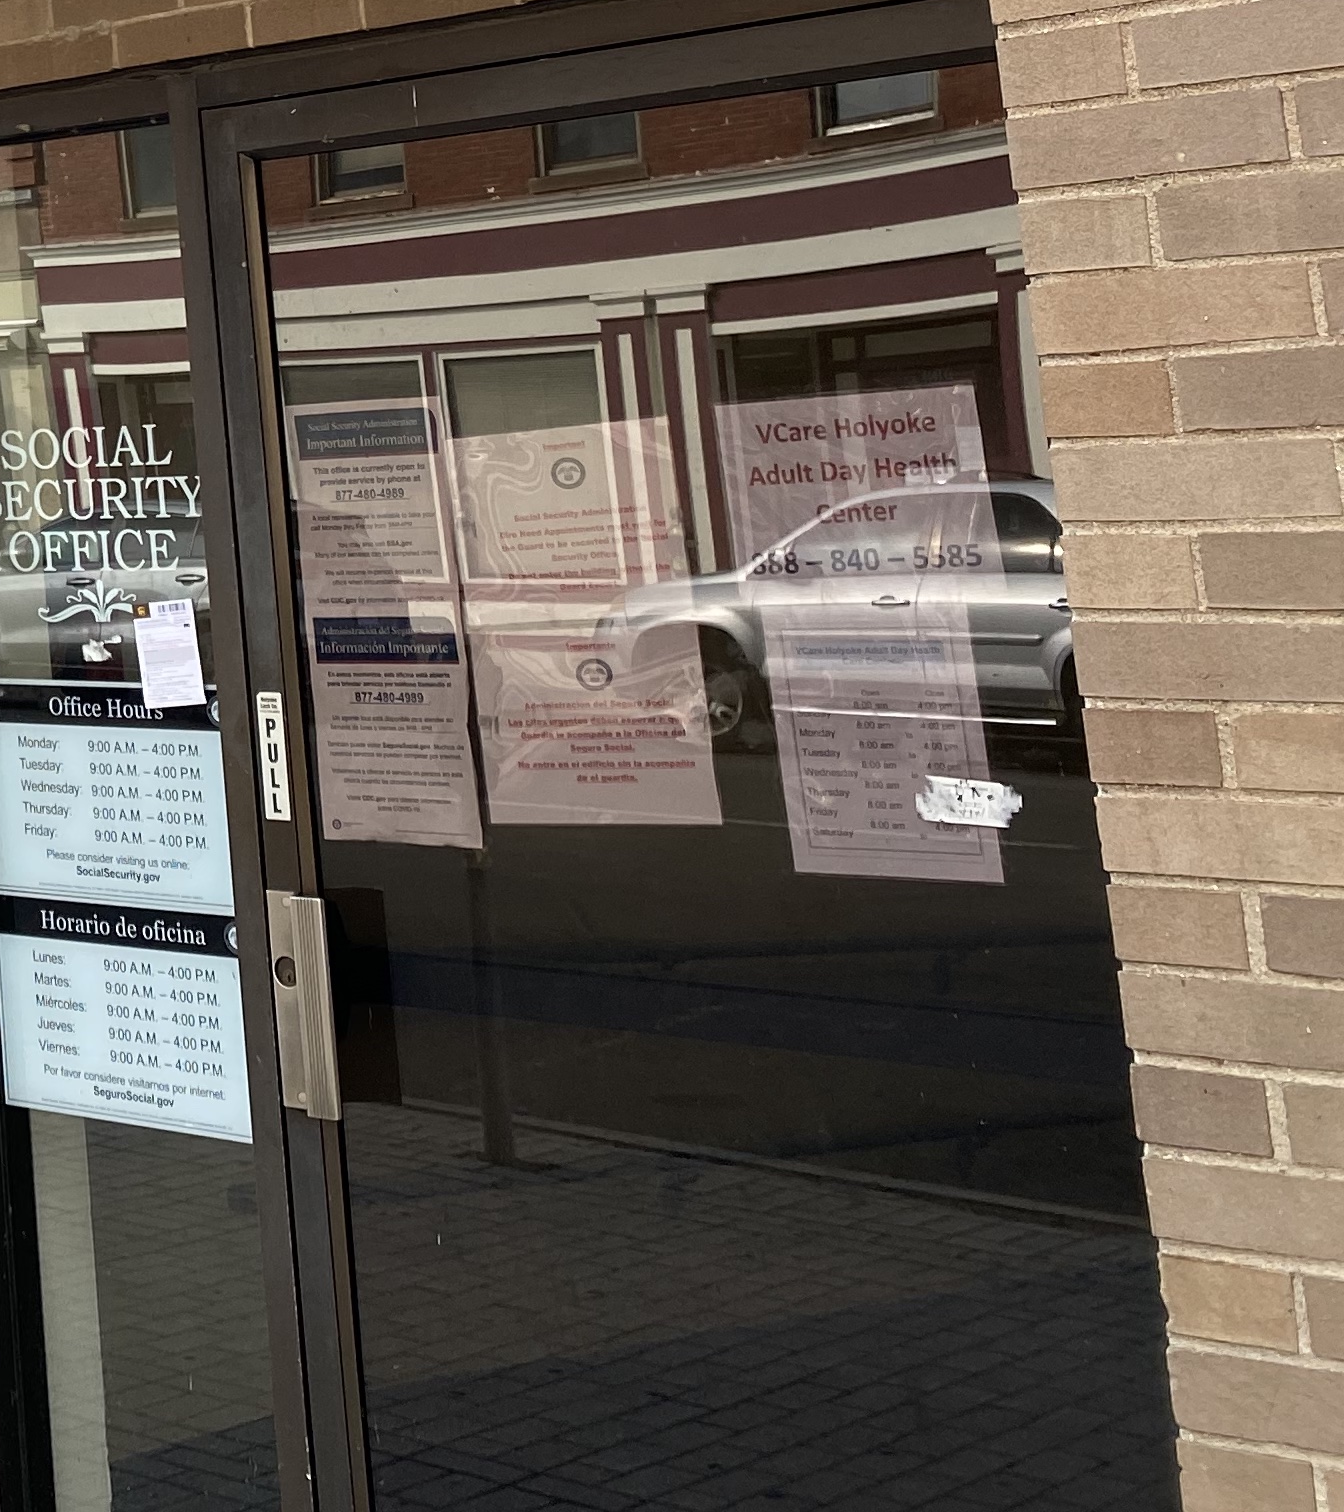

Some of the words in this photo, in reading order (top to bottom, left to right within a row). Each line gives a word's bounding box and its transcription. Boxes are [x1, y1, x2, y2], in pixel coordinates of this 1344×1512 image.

[755, 423, 827, 444] VCare
[833, 411, 937, 441] Holyoke
[0, 423, 173, 471] SOCIAL
[306, 436, 356, 452] Important
[359, 433, 425, 447] Information
[749, 461, 814, 486] Adult
[820, 461, 867, 485] Day
[873, 452, 957, 479] Health
[815, 503, 898, 525] Center
[8, 528, 180, 573] OFFICE
[830, 547, 880, 572] 840
[319, 640, 386, 654] Información
[388, 640, 449, 657] Importante
[48, 695, 102, 718] Office
[106, 698, 164, 720] Hours
[87, 740, 111, 753] 9:00
[151, 743, 175, 756] 4:00
[89, 762, 113, 775] 9:00
[153, 765, 177, 779] 4:00
[265, 717, 283, 814] PULL
[91, 784, 115, 798] 9:00
[155, 788, 179, 802] 4:00
[92, 806, 116, 820] 9:00
[157, 811, 181, 825] 4:00
[94, 829, 118, 843] 9:00
[159, 834, 182, 847] 4:00
[46, 848, 75, 861] Please
[77, 853, 114, 864] consider
[116, 855, 146, 869] visiting
[148, 858, 159, 868] us
[76, 865, 161, 884] SocialSecurity.gov
[40, 909, 111, 936] Horario
[115, 915, 137, 939] de
[142, 919, 207, 946] oficina
[32, 949, 66, 966] Lunes:
[103, 958, 127, 973] 9:00
[167, 966, 192, 980] 4:00
[34, 971, 72, 988] Martes:
[105, 981, 128, 996] 9:00
[170, 989, 193, 1004] 4:00
[106, 1004, 130, 1019] 9:00
[172, 1012, 195, 1027] 4:00
[37, 1015, 76, 1033] Jueves:
[108, 1027, 132, 1042] 9:00
[173, 1035, 197, 1050] 4:00
[38, 1037, 81, 1056] Viernes:
[110, 1050, 133, 1065] 9:00
[175, 1058, 199, 1074] 4:00
[43, 1063, 59, 1077] Por
[61, 1065, 82, 1079] favor
[83, 1071, 126, 1086] considere
[172, 1084, 187, 1096] por
[93, 1085, 175, 1109] SeguroSocial.gov
